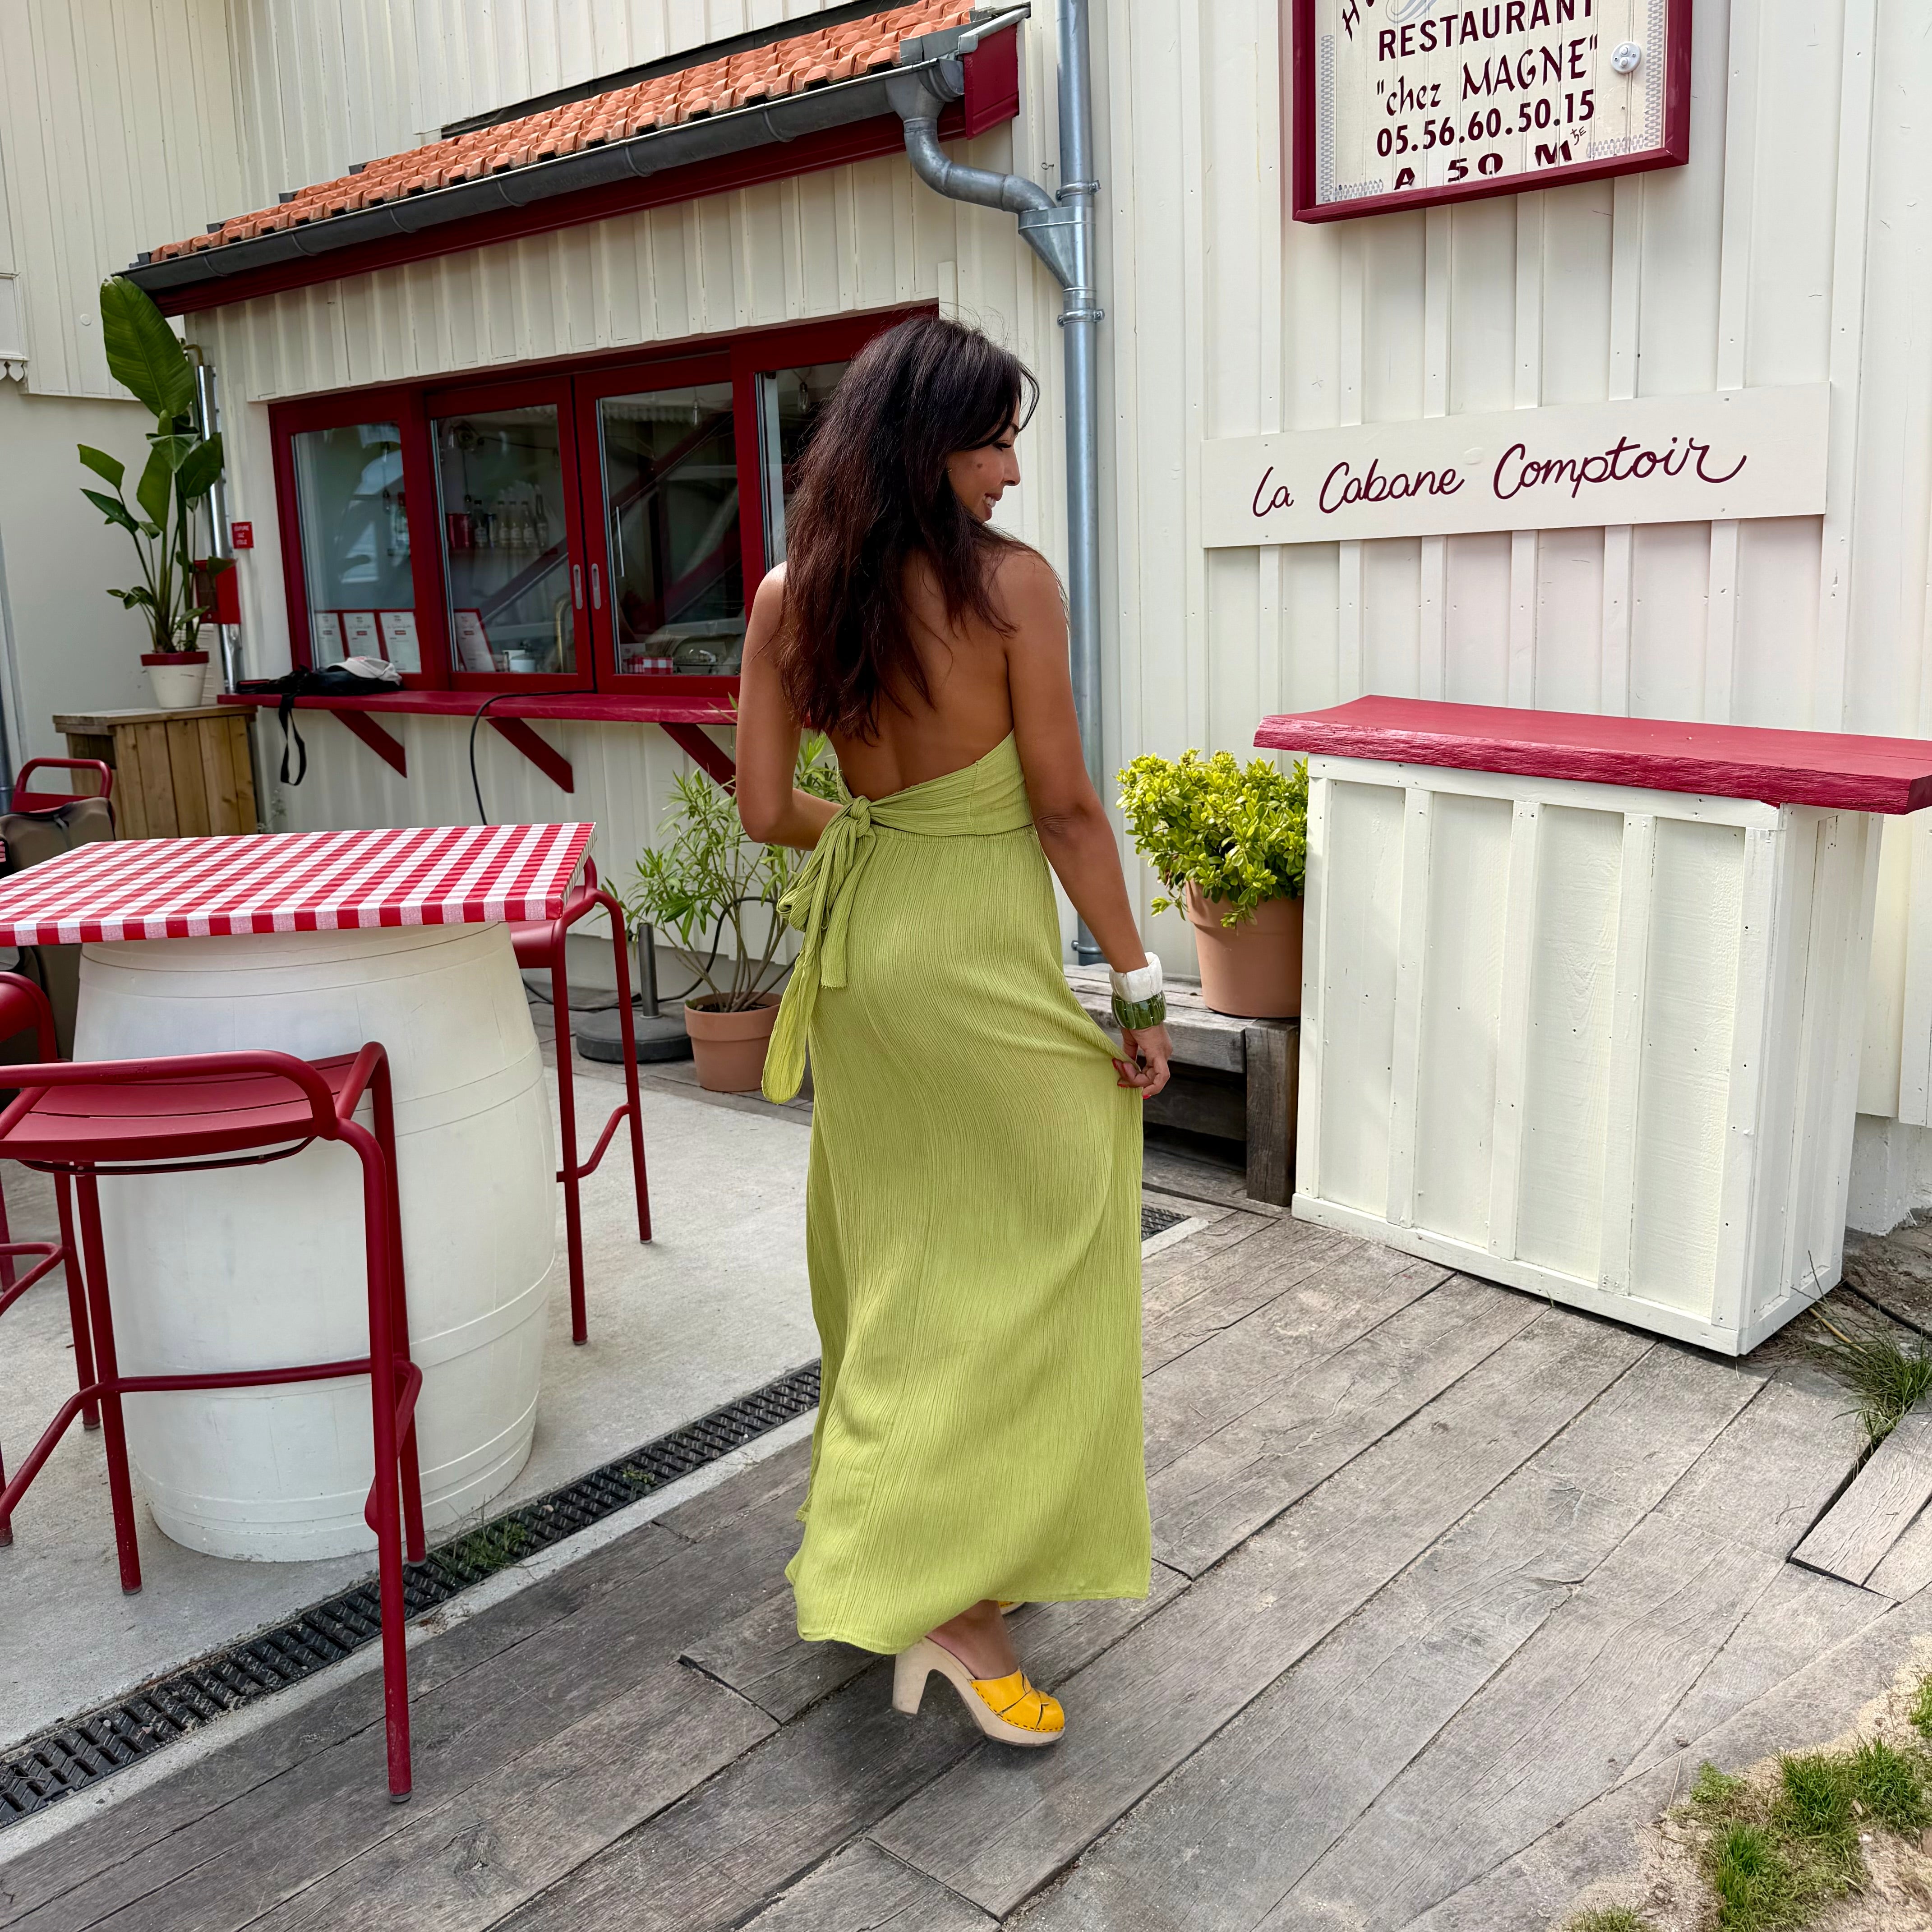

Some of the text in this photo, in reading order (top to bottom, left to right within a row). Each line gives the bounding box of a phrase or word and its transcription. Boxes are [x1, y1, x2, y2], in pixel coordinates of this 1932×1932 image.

[1462, 34, 1598, 101] MAGNE"
[1377, 89, 1594, 157] 05.56.60.50.15
[1394, 167, 1416, 190] A
[1252, 436, 1747, 517] La Cabane Comptoir
